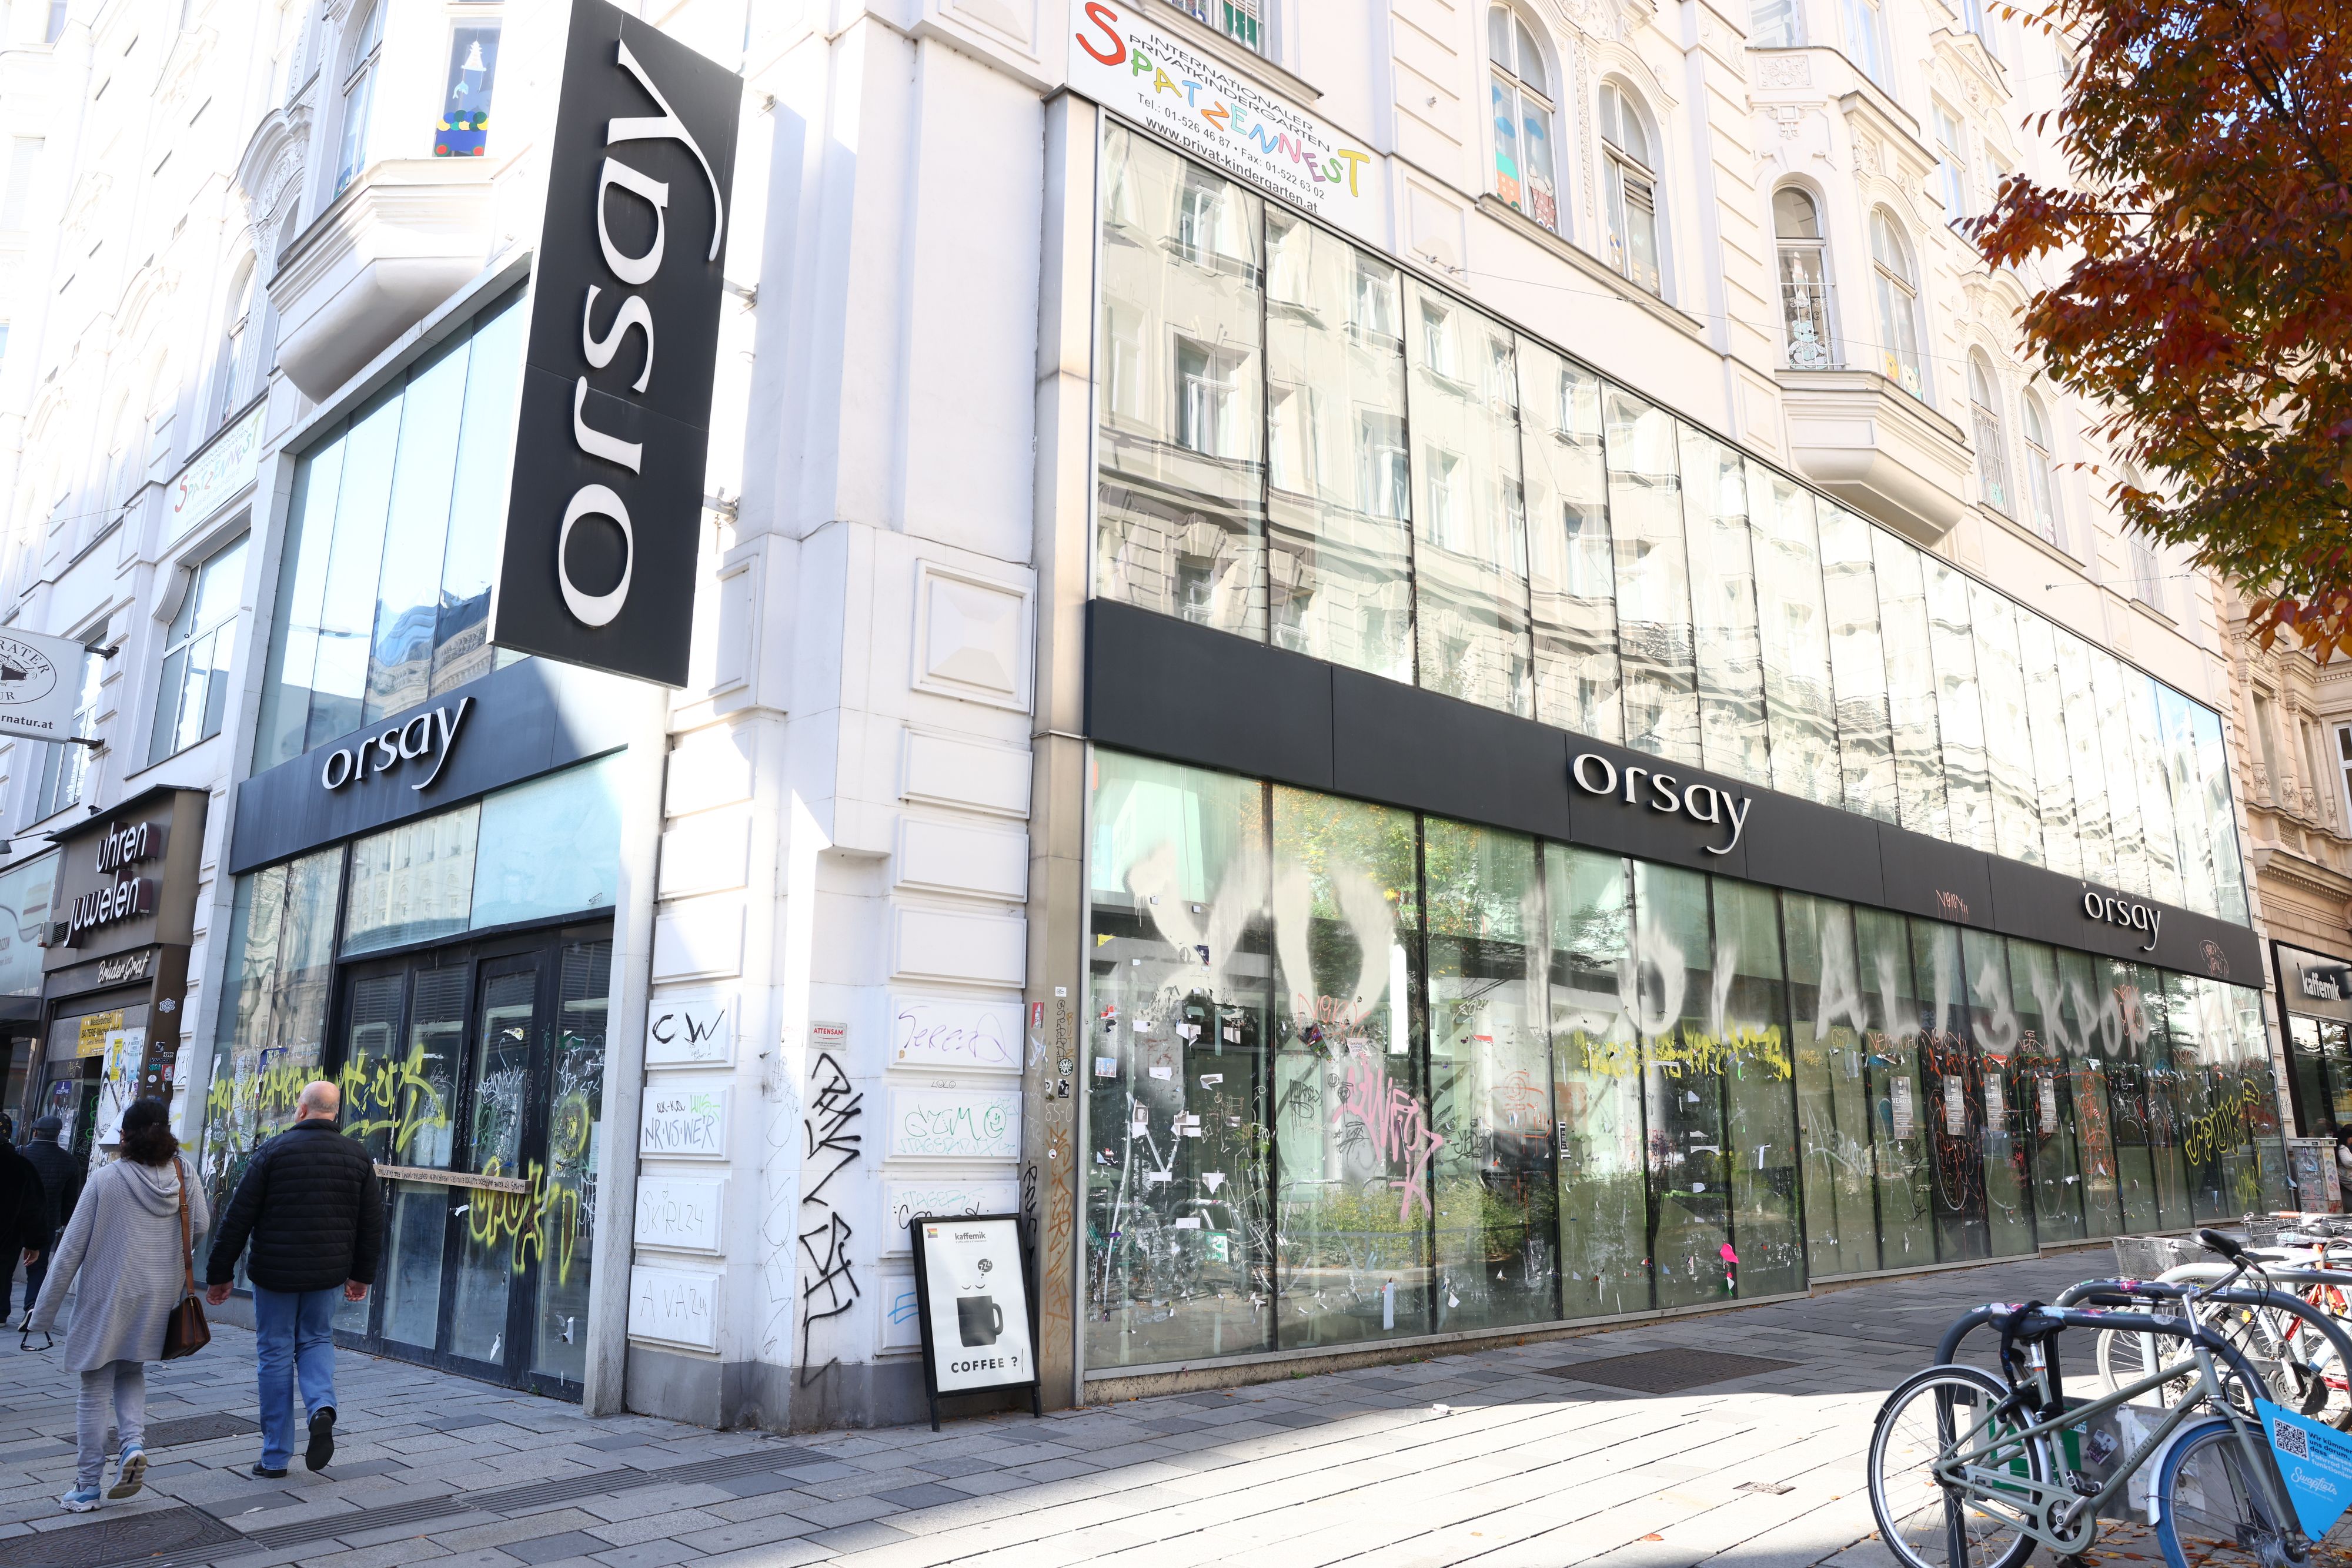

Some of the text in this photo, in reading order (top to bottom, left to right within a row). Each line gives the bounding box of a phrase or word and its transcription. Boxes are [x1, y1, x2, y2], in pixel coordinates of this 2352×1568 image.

[1130, 34, 1330, 153] PRIVATKINDERGARTEN
[1150, 34, 1313, 132] INTERNATIONALER
[1137, 92, 1325, 200] Tel.: 01-526 46 87 Fax: 01-522 63 02
[558, 39, 723, 628] orsay
[322, 696, 470, 790] orsay
[1573, 753, 1752, 854] orsay
[2084, 891, 2161, 951] orsay
[123, 950, 150, 981] Graf
[2300, 968, 2341, 1001] kaffemik
[813, 1027, 843, 1035] ATTENSAM
[954, 1231, 986, 1240] kaffemik
[951, 1356, 1018, 1373] COFFEE ?
[2308, 1431, 2321, 1442] Wir
[2309, 1439, 2351, 1460] uns darum,
[2310, 1446, 2327, 1457] dass
[2122, 1437, 2153, 1470] SWAPFIETS
[2310, 1452, 2340, 1468] Fahrrad
[2290, 1466, 2337, 1496] Swapfiets
